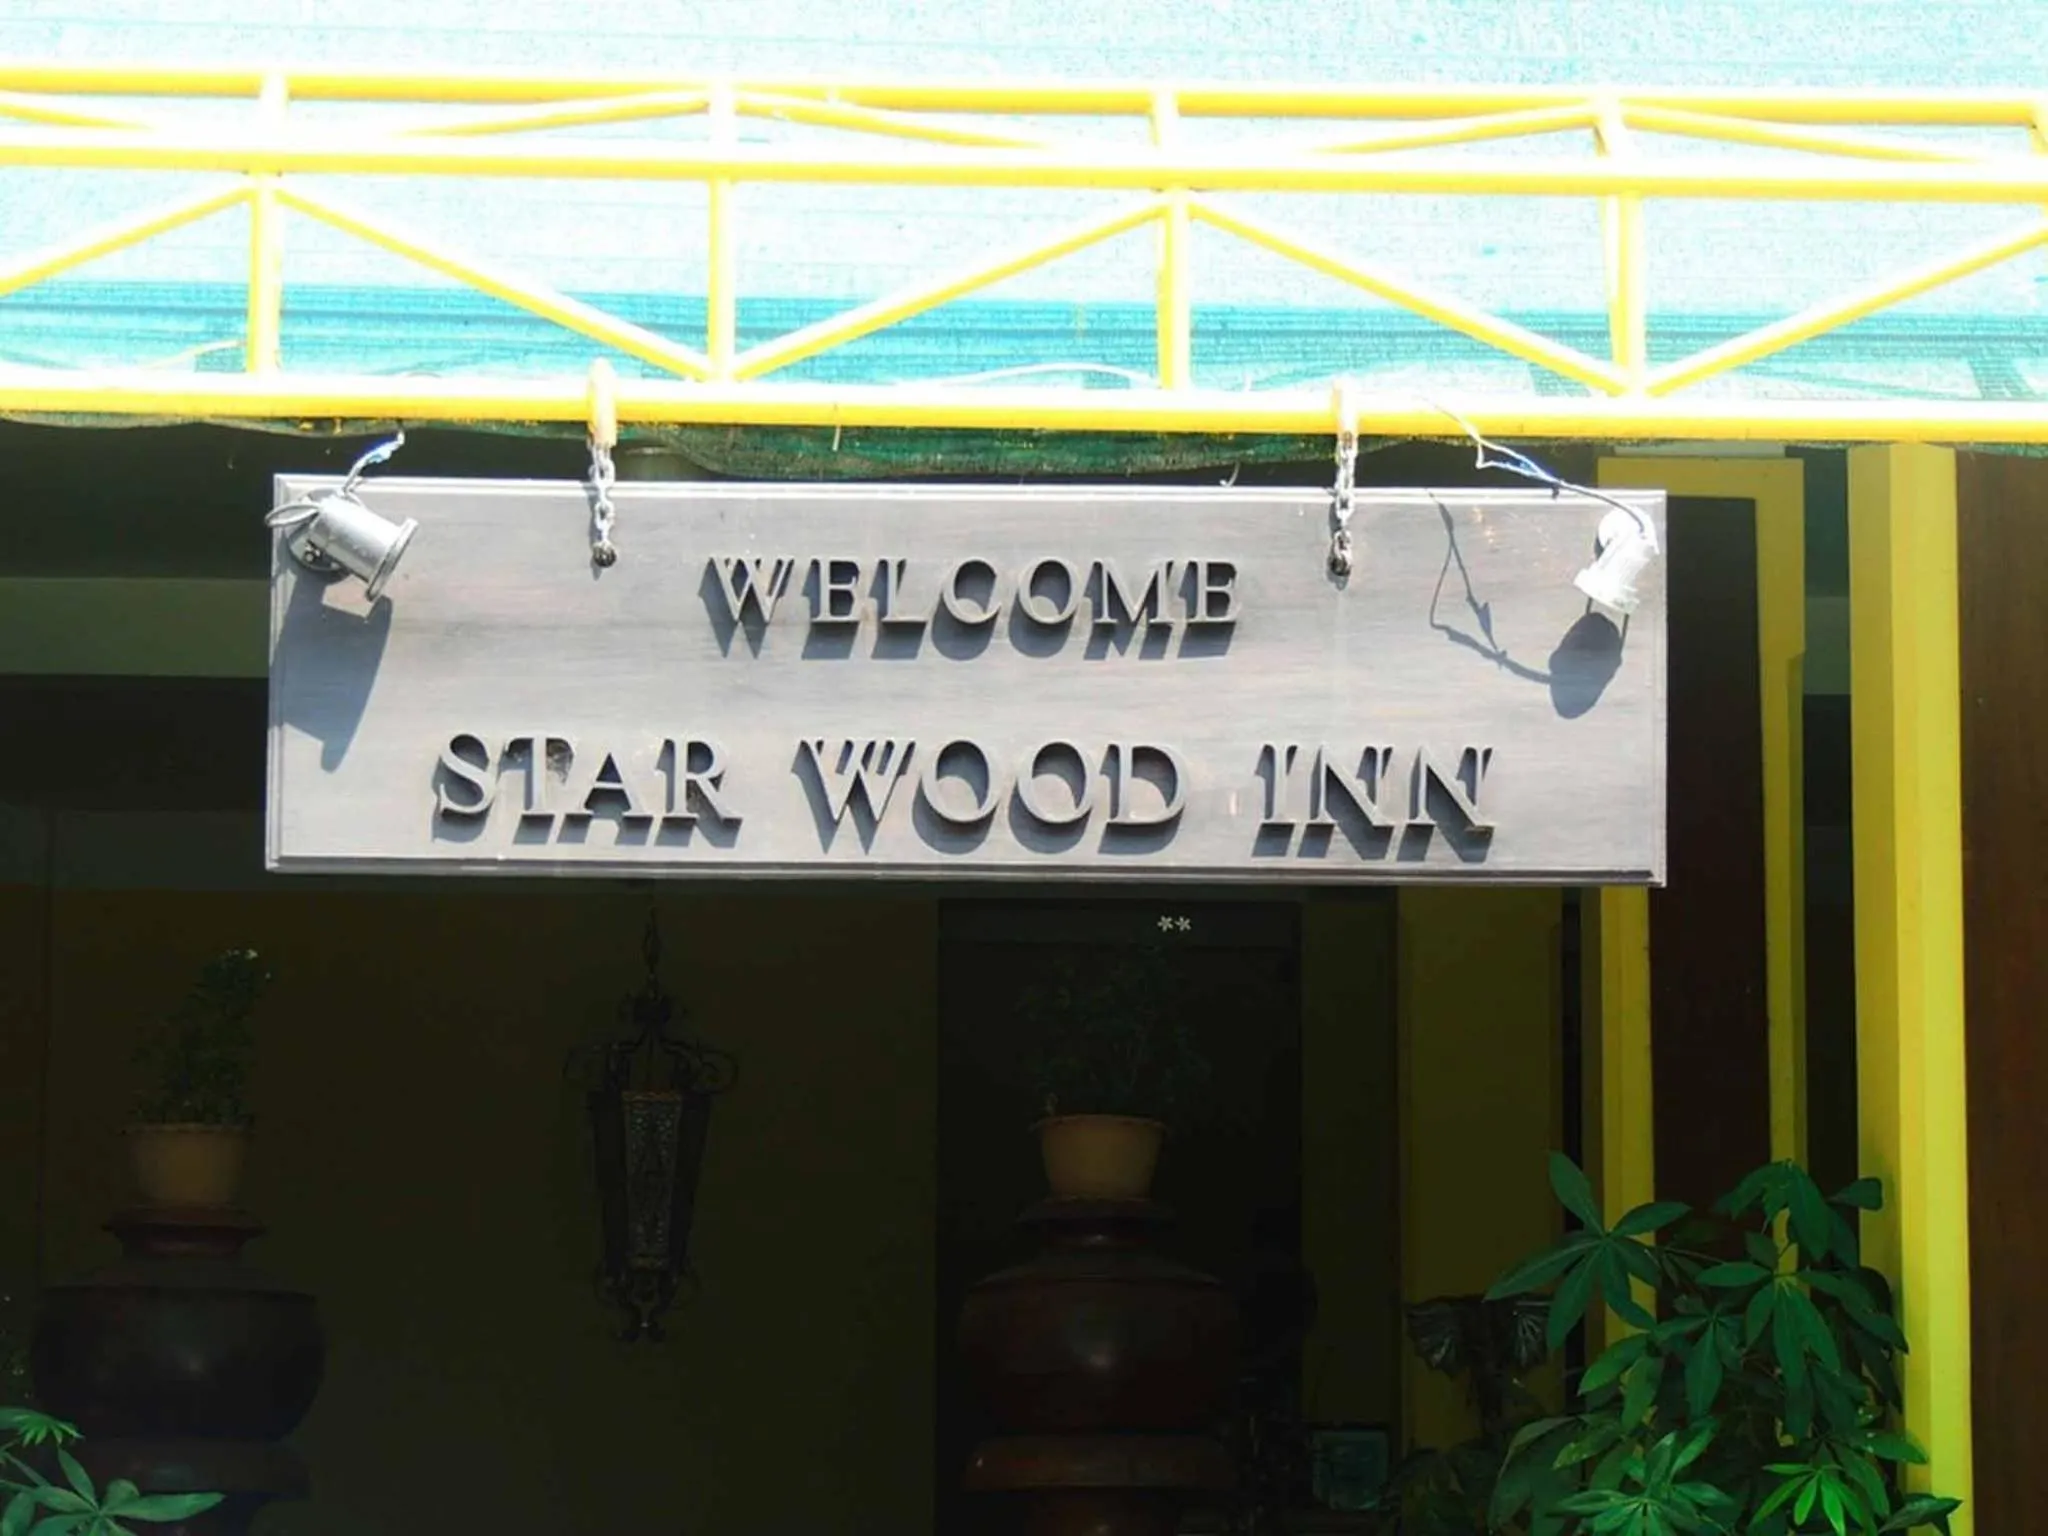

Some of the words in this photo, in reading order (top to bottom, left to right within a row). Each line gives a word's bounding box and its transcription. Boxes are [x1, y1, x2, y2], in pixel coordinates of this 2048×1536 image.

[702, 555, 1244, 628] WELCOME
[436, 732, 743, 822] STAR
[796, 736, 1186, 826] WOOD
[1256, 742, 1497, 832] INN
